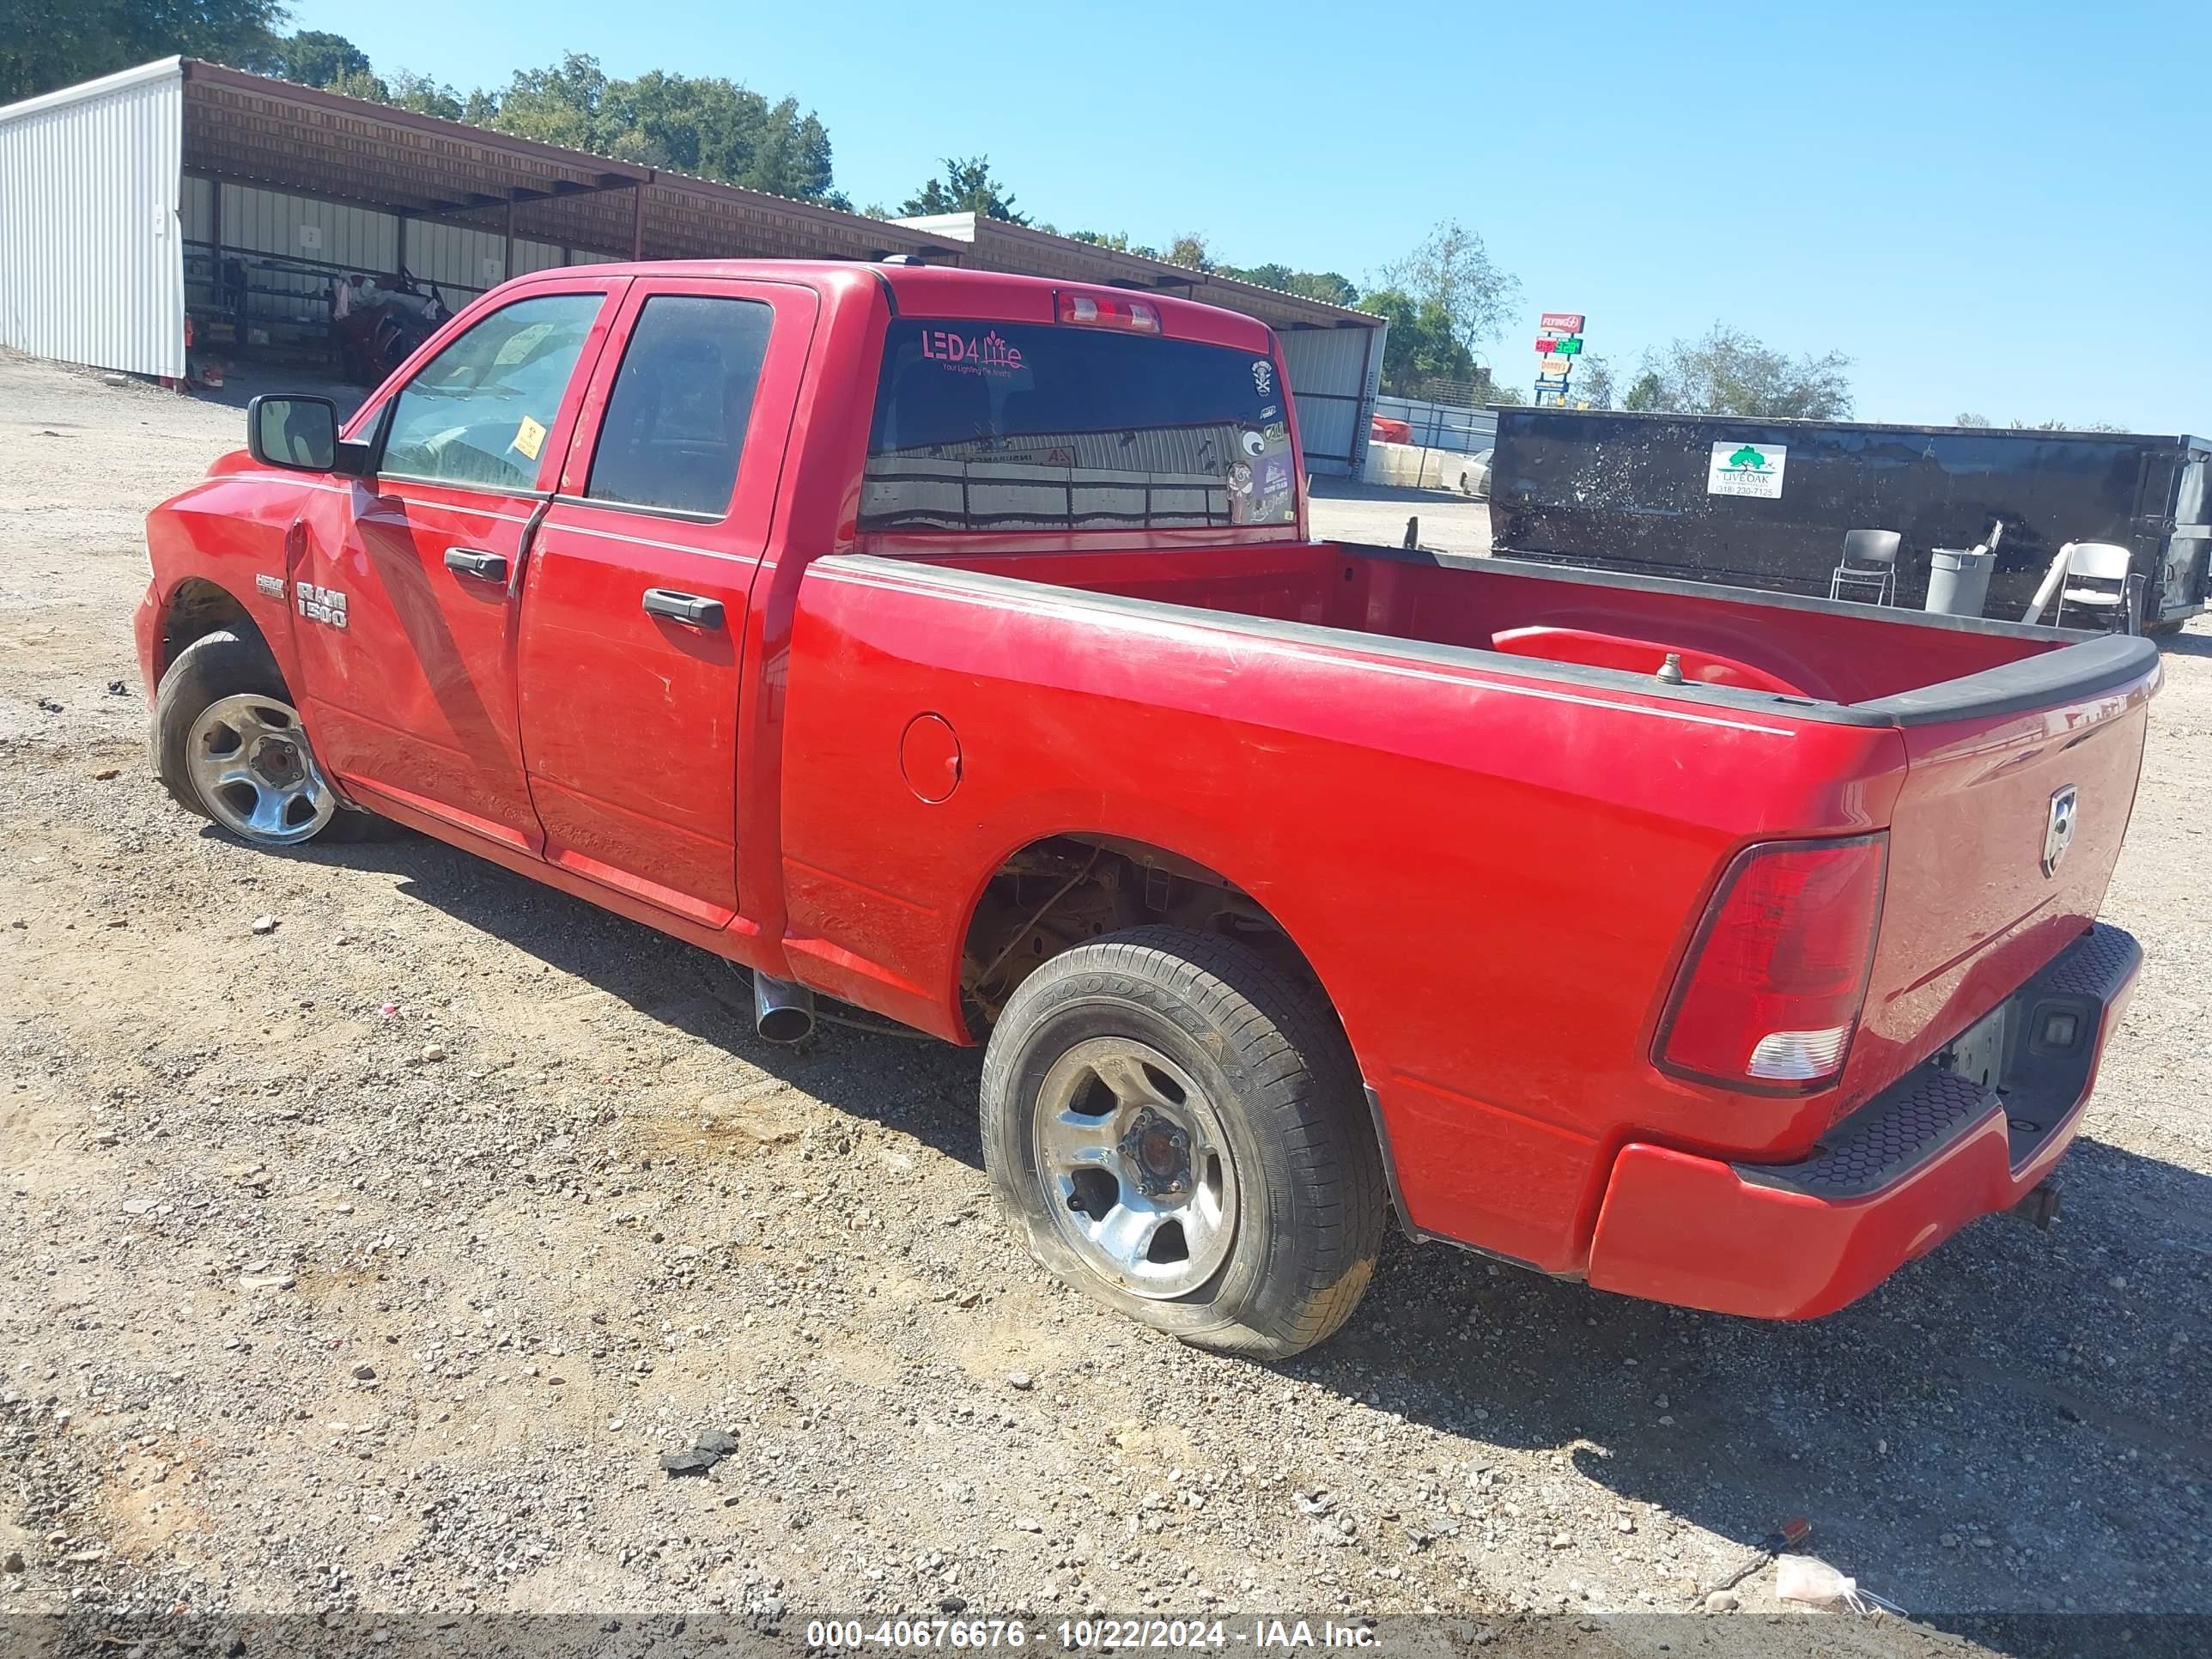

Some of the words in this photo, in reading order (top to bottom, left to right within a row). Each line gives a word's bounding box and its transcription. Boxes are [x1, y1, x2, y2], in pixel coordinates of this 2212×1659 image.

[1542, 317, 1568, 327] FLYING
[943, 362, 957, 372] Your
[1736, 486, 1773, 496] 230-7125
[256, 574, 284, 592] HEMI
[296, 581, 347, 611] RAM
[297, 599, 348, 629] 1500
[1036, 975, 1252, 1097] GOODYEAR
